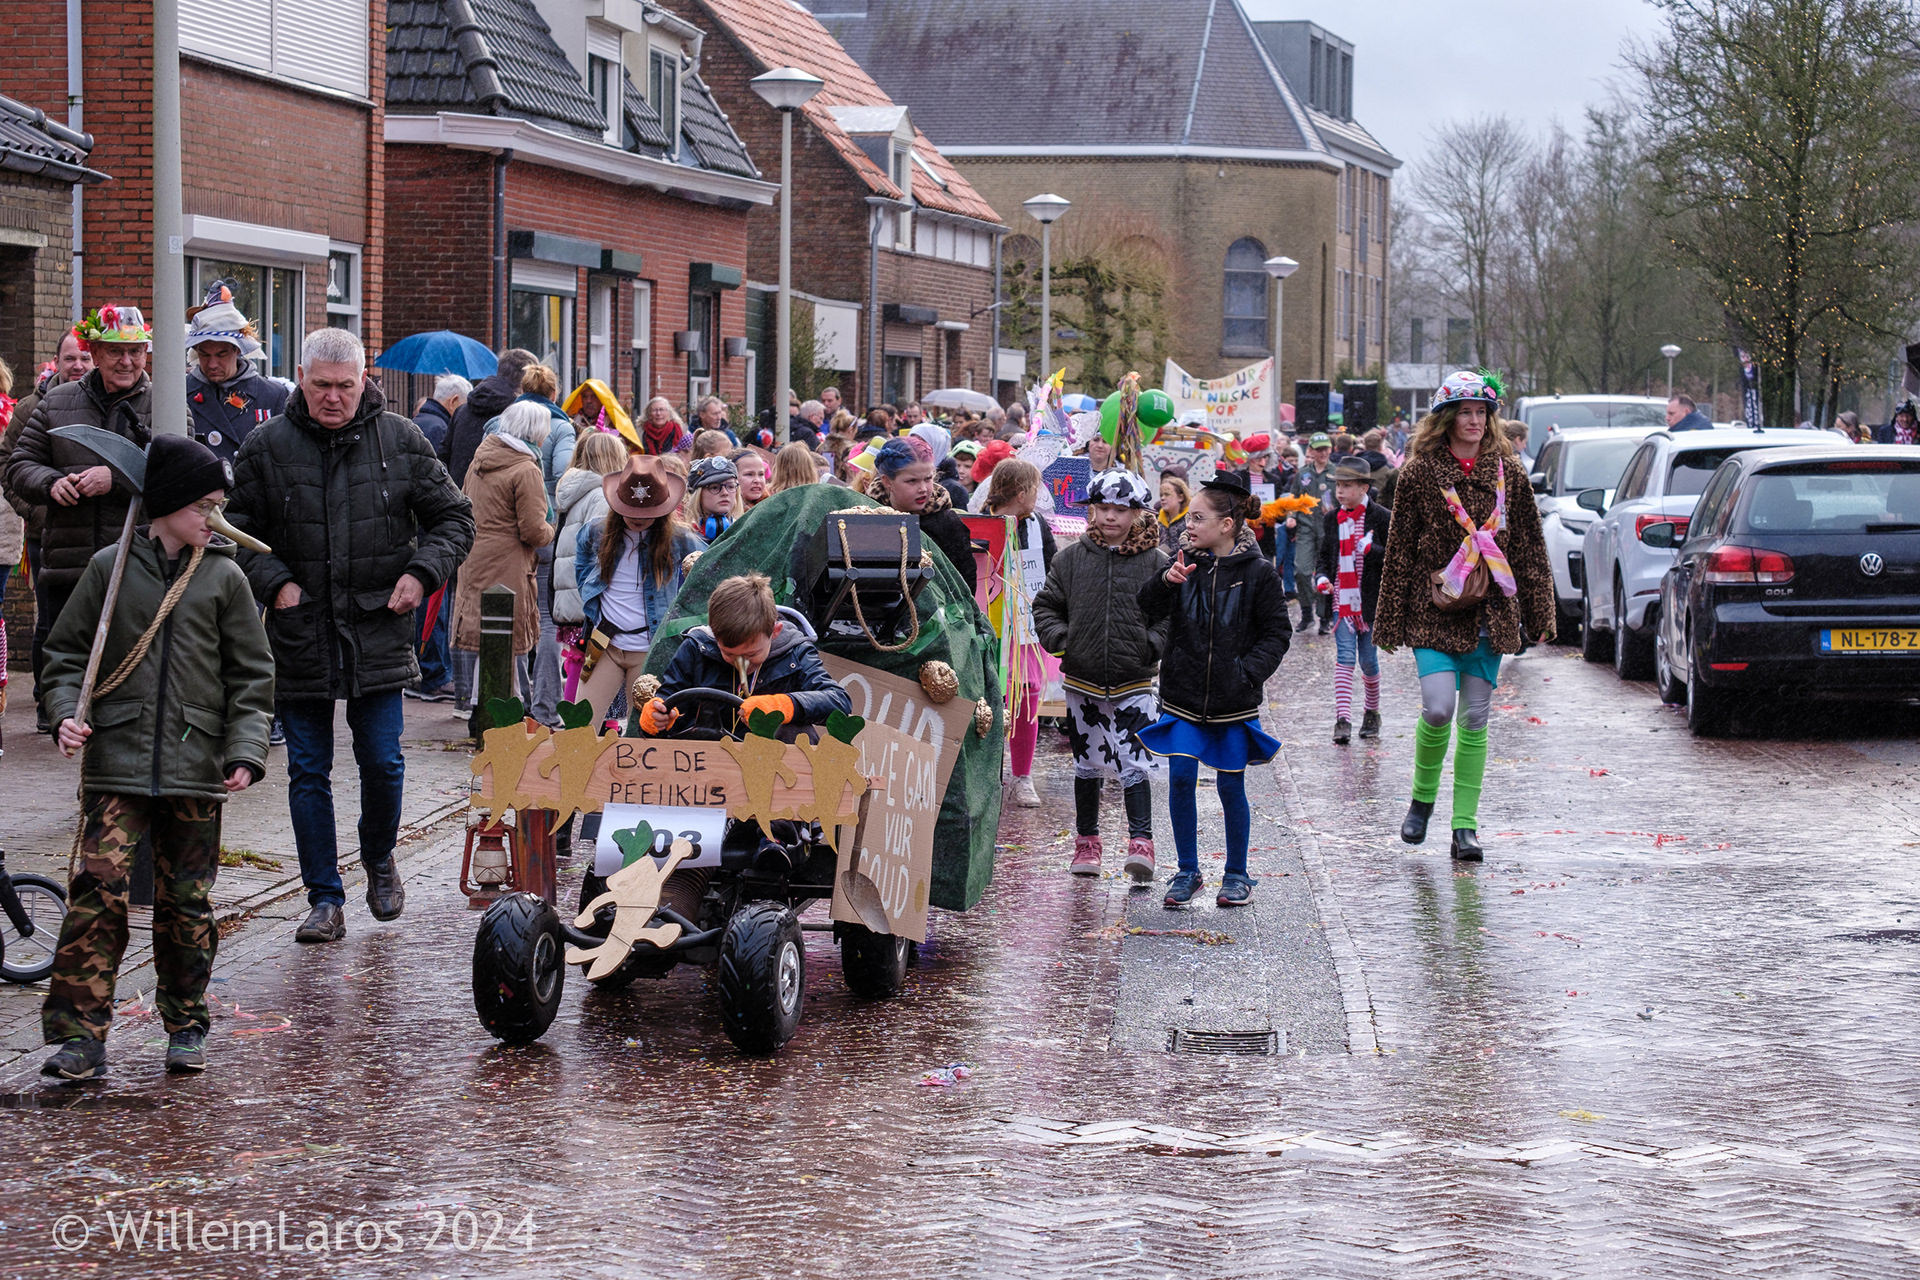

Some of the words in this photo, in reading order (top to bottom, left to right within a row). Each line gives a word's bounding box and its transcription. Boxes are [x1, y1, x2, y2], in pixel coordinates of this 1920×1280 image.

[1207, 386, 1260, 403] NUSKE
[1205, 404, 1238, 417] VOR
[1765, 588, 1794, 596] GOLF
[1841, 631, 1919, 648] NL-178-Z
[673, 750, 707, 772] DE
[861, 740, 899, 807] WE
[617, 827, 703, 861] 03
[885, 811, 914, 862] VUR
